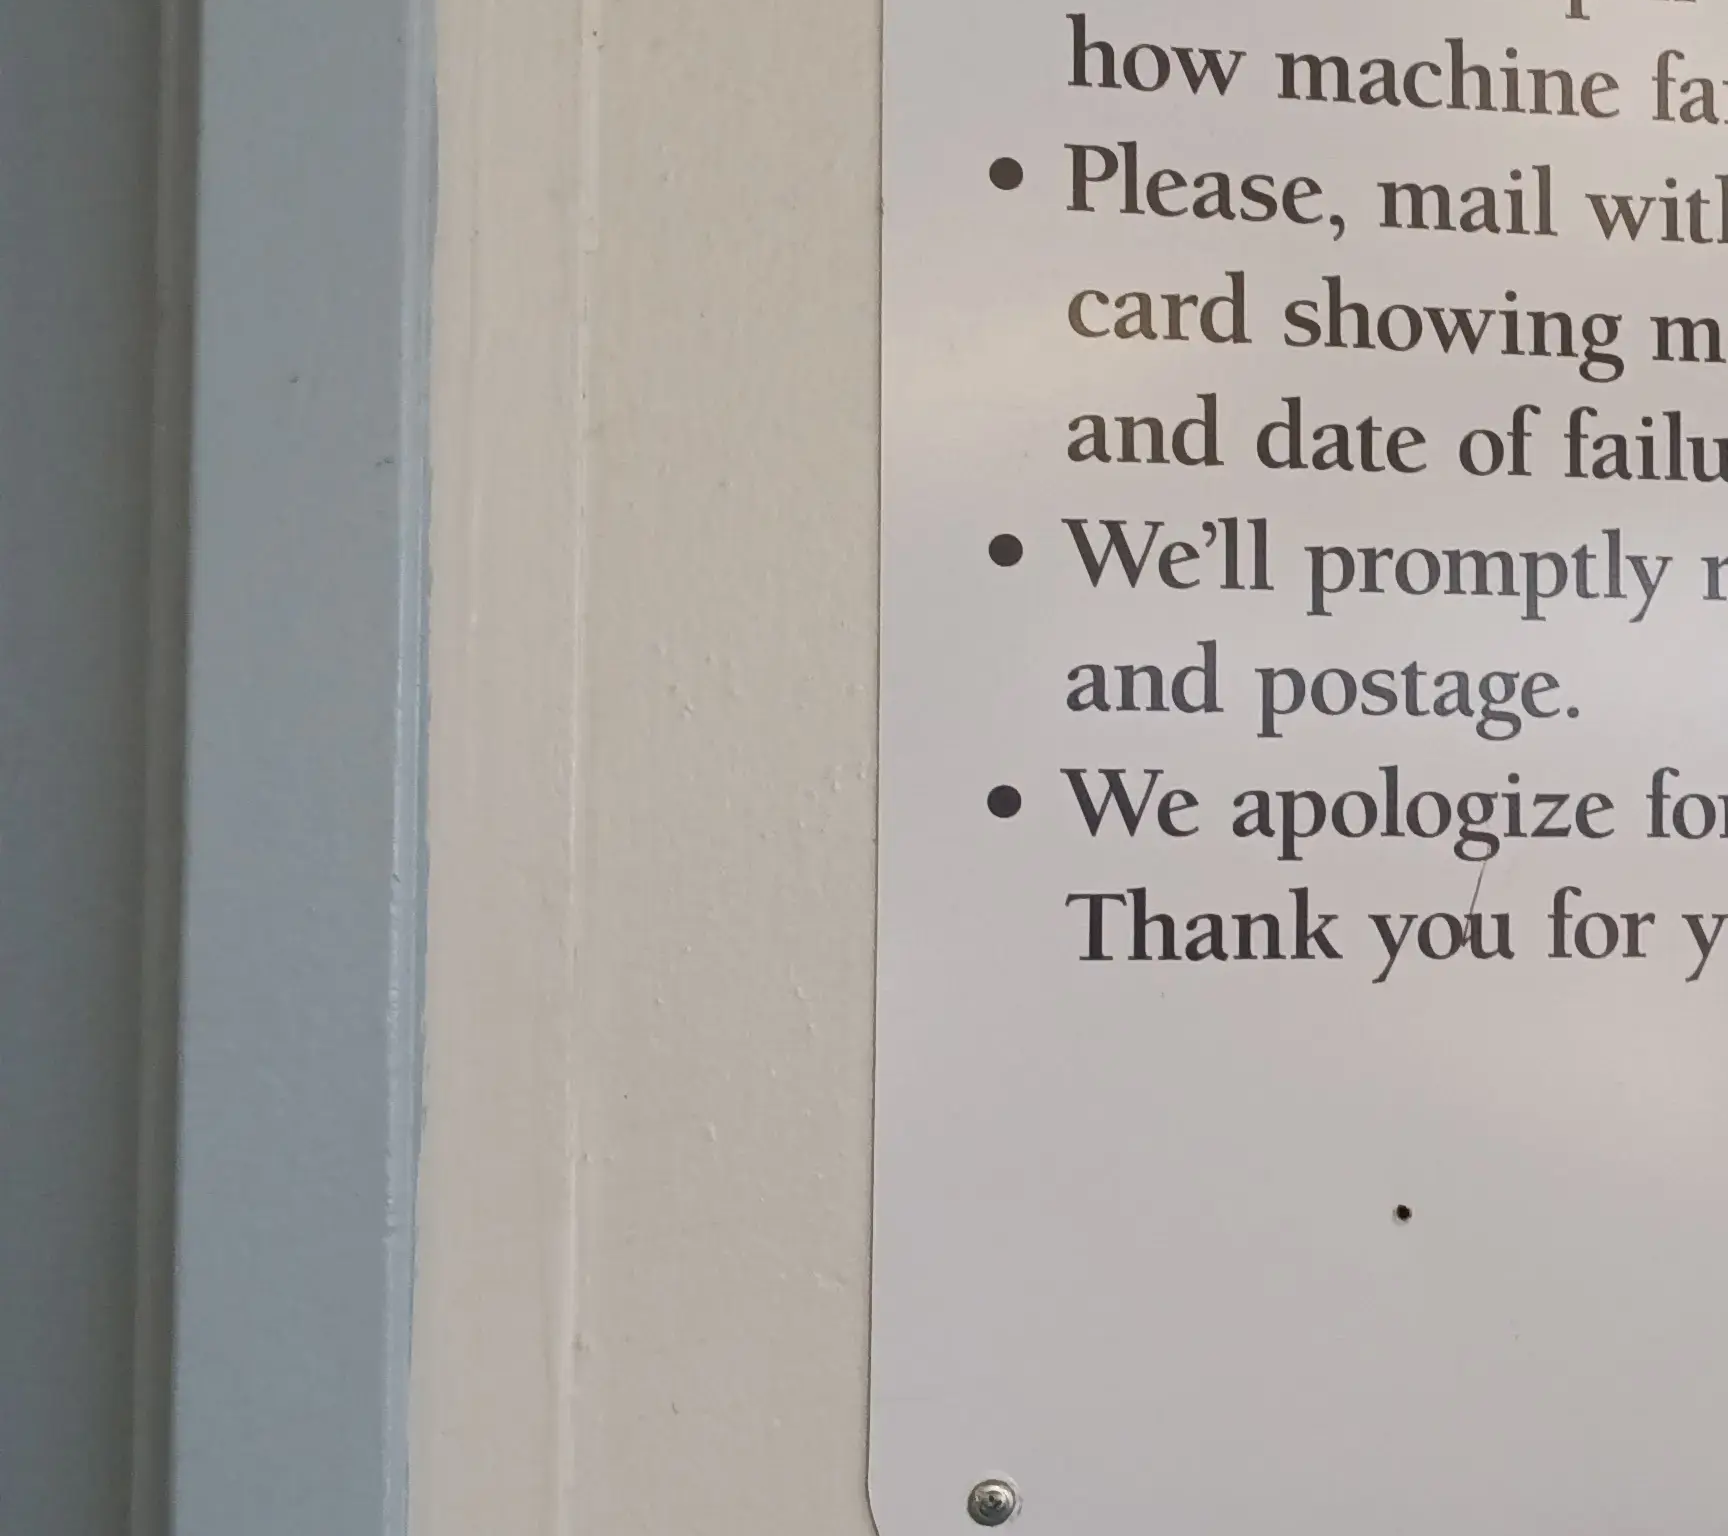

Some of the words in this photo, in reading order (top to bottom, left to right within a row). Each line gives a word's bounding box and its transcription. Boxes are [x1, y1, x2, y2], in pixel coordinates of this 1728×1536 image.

[1066, 13, 1246, 95] how
[1275, 38, 1619, 118] machine
[1064, 141, 1344, 241] Please,
[1377, 165, 1557, 236] mail
[1068, 270, 1252, 344] card
[1284, 275, 1624, 383] showing
[1068, 393, 1224, 466] and
[1257, 397, 1426, 473] date
[1459, 404, 1541, 476] of
[1304, 528, 1673, 623] promptly
[1067, 640, 1224, 713] and
[1255, 661, 1579, 741] postage.
[1060, 769, 1199, 837] We
[1233, 765, 1614, 862] apologize
[1065, 887, 1343, 961] Thank
[1369, 899, 1514, 983] you
[1548, 888, 1655, 959] for
